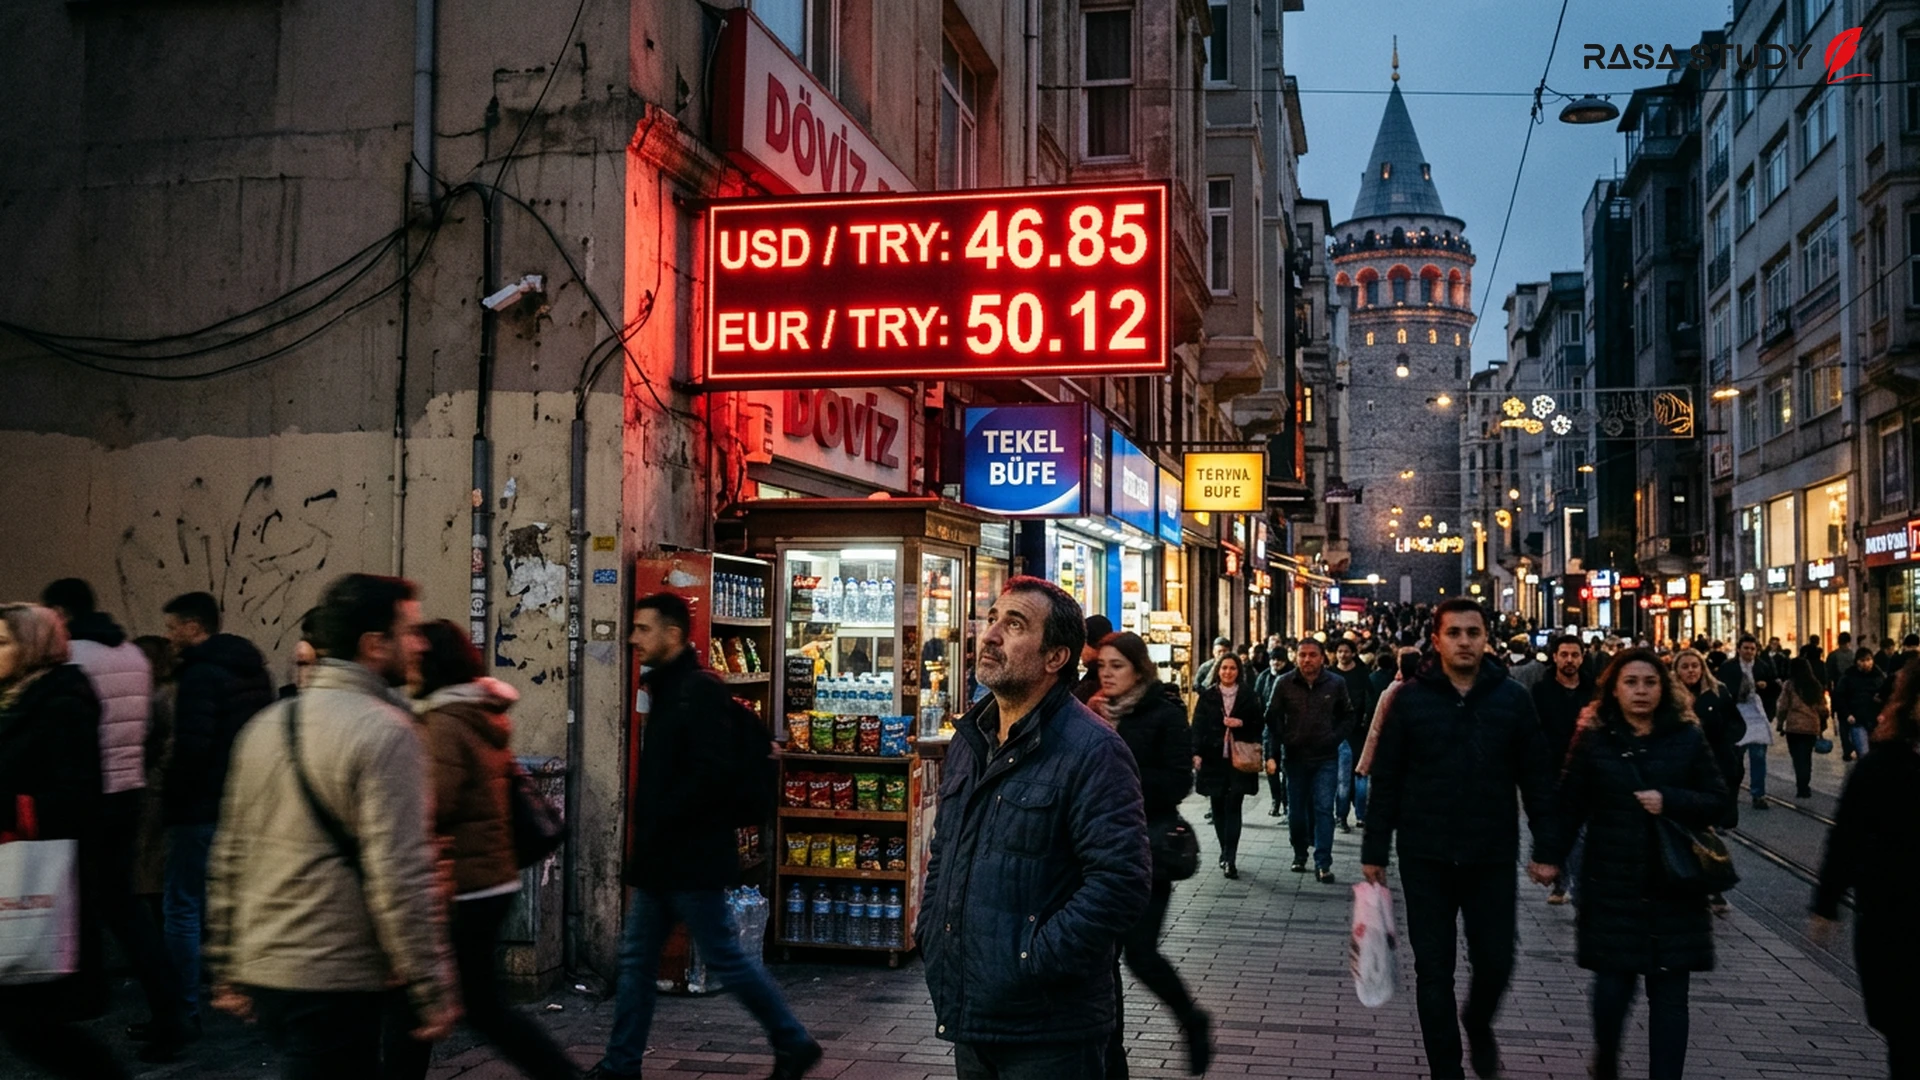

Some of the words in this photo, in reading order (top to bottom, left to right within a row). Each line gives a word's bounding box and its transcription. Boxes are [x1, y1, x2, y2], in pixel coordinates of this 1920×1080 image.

[720, 228, 811, 270] USD
[823, 226, 838, 266] /
[850, 222, 949, 264] TRY:
[965, 203, 1148, 269] 46.85
[718, 311, 810, 352] EUR
[821, 309, 836, 349] /
[849, 306, 948, 348] TRY:
[966, 288, 1147, 355] 50.12
[982, 429, 1064, 454] TEKEL
[989, 456, 1057, 485] BÜFE
